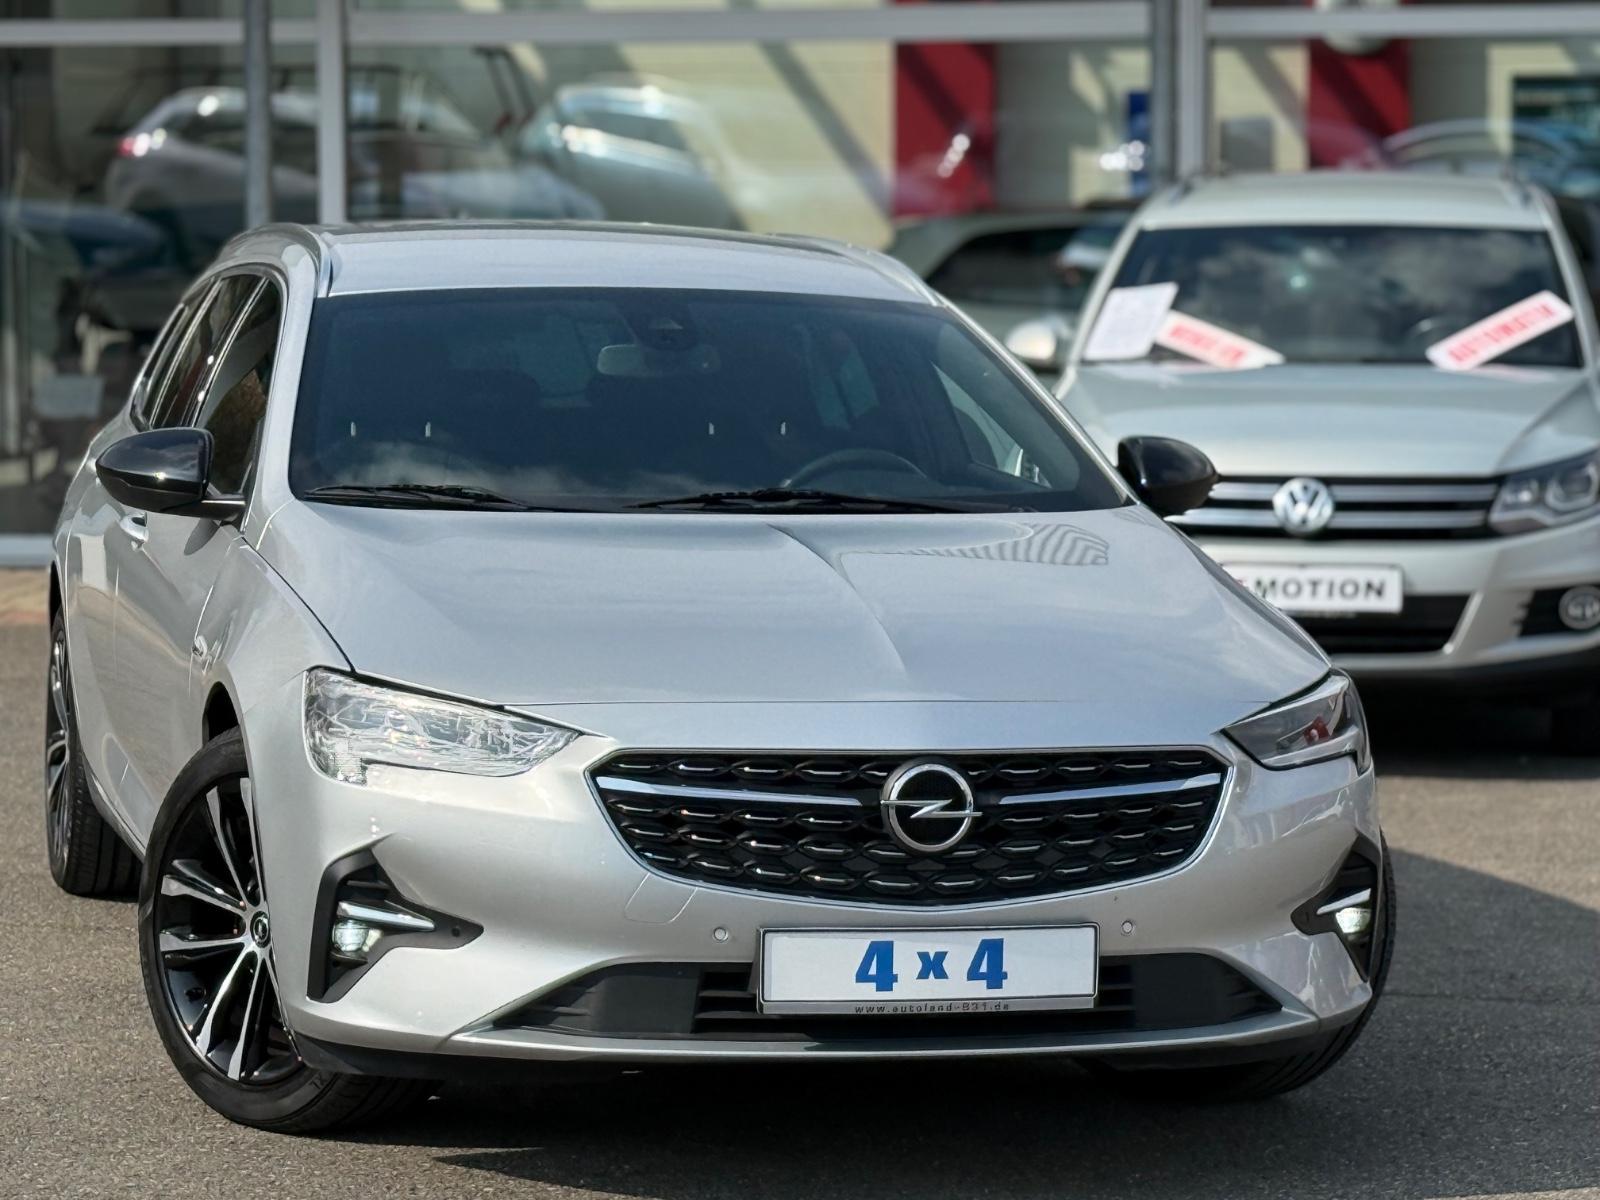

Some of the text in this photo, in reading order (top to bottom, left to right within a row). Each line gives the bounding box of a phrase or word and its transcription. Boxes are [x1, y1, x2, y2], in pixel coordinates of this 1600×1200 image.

[855, 938, 1008, 992] 4 x 4
